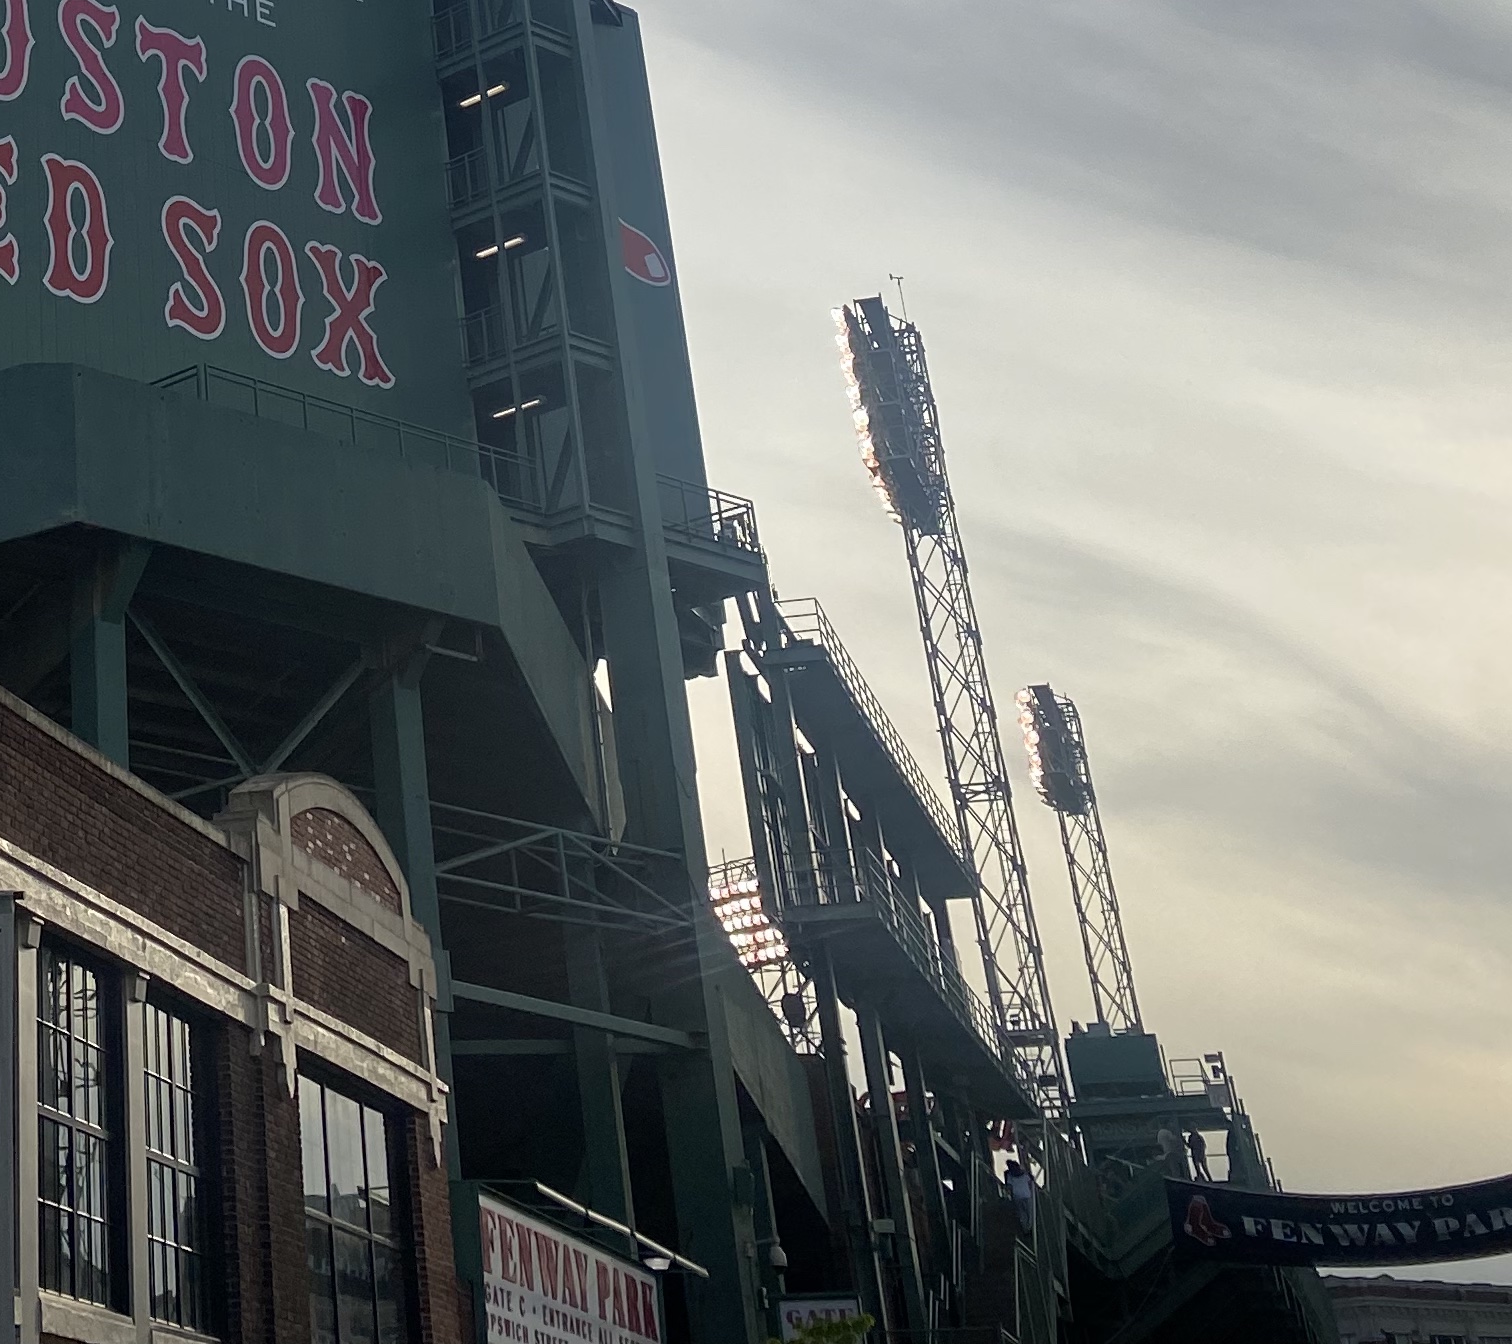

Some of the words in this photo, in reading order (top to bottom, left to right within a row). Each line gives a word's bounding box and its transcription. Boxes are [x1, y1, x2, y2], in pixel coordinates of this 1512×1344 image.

[161, 195, 395, 389] SOX
[1241, 1215, 1421, 1246] FENWAY
[1330, 1198, 1424, 1214] WELCOME
[1429, 1194, 1455, 1208] TO
[480, 1206, 588, 1313] FENWAY
[595, 1258, 659, 1342] PARK
[485, 1280, 513, 1312] GATE
[519, 1295, 526, 1318] C
[542, 1304, 593, 1343] ENTRANCE
